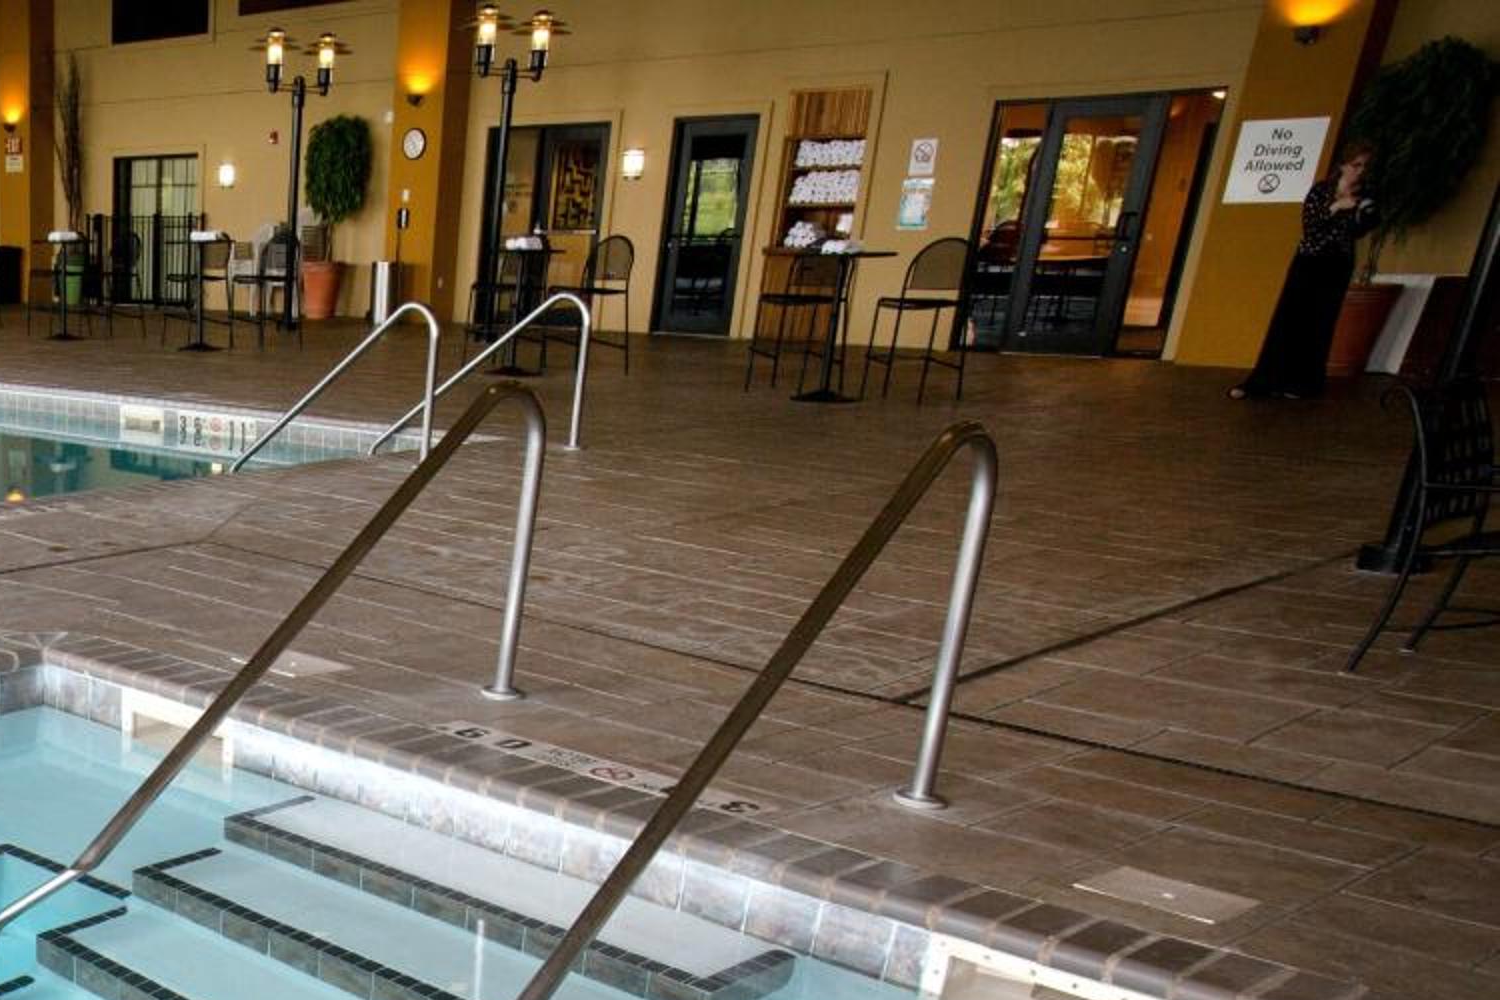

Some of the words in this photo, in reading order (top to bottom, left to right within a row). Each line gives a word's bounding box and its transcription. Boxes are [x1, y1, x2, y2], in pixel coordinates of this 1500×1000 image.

[1271, 127, 1293, 140] No
[1253, 144, 1303, 159] Diving
[1244, 157, 1306, 171] Allowed
